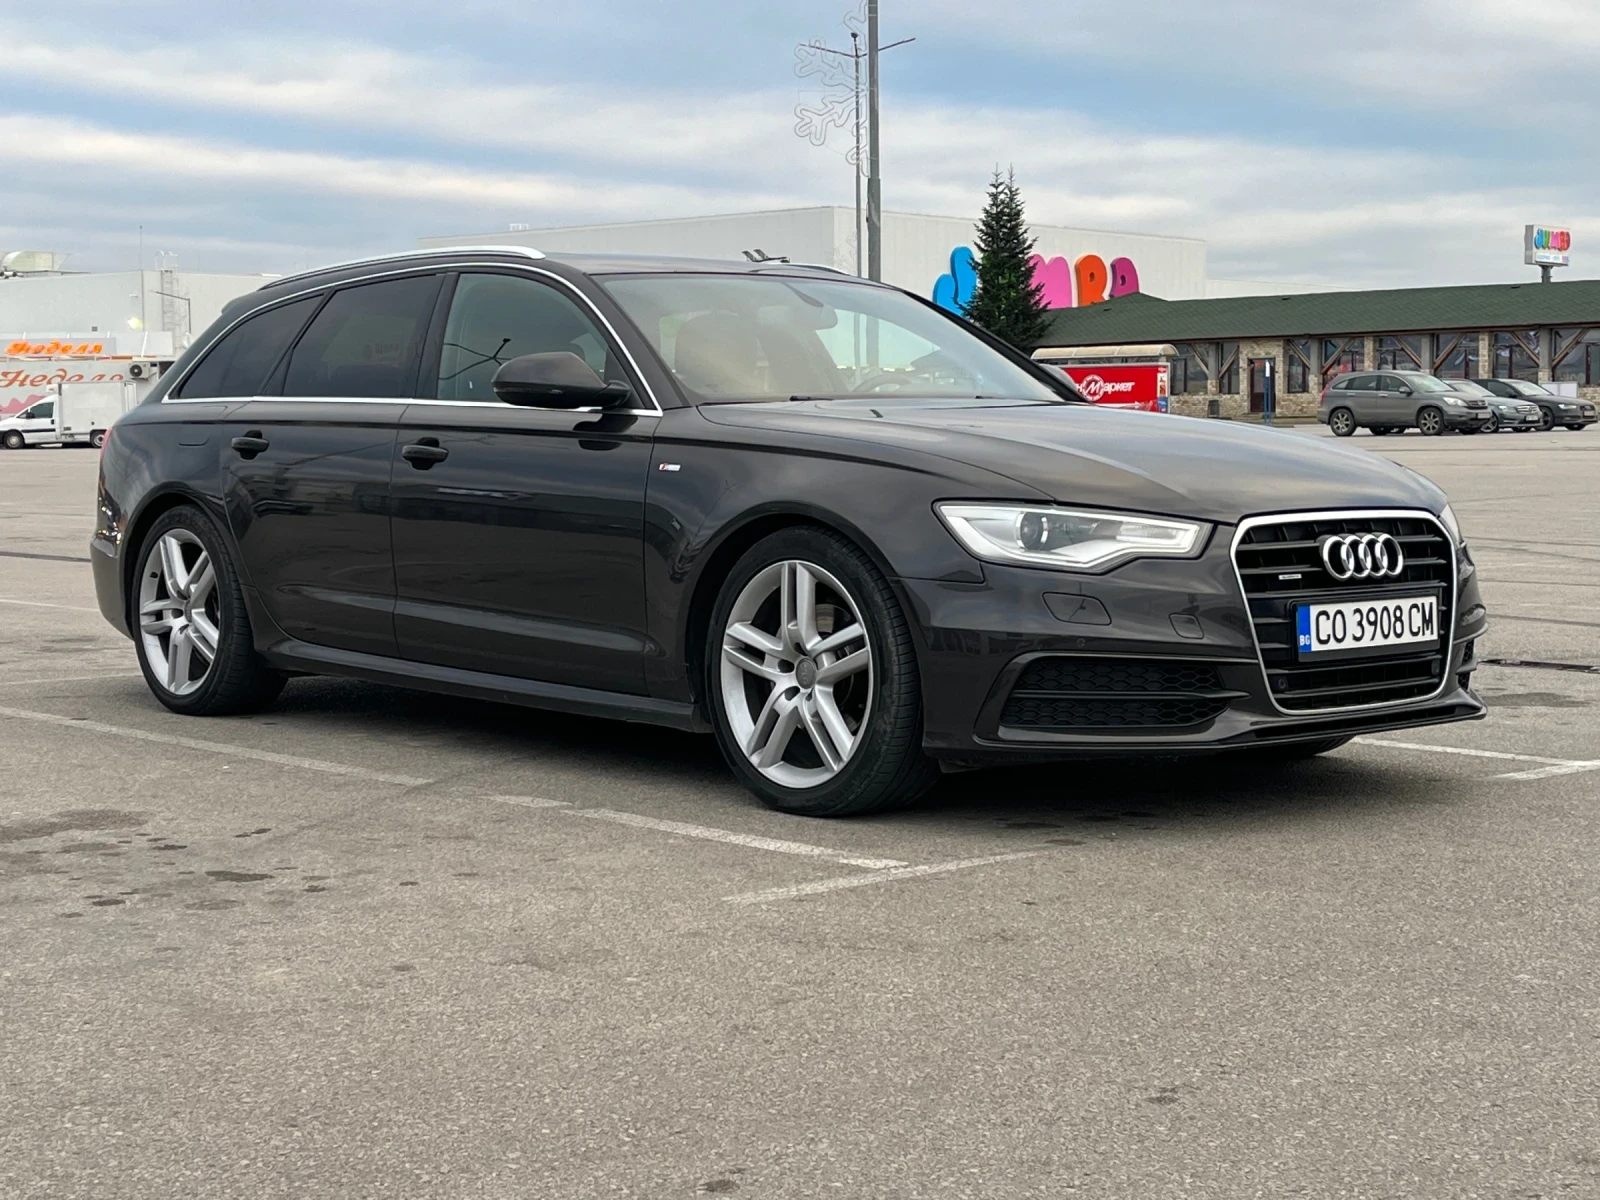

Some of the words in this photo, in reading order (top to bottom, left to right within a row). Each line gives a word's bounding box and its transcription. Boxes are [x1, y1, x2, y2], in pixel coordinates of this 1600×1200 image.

[932, 246, 1140, 318] JMBO
[1299, 634, 1311, 646] BG
[1315, 609, 1347, 645] CO
[1352, 604, 1405, 642] 3908
[1408, 601, 1434, 637] CM
